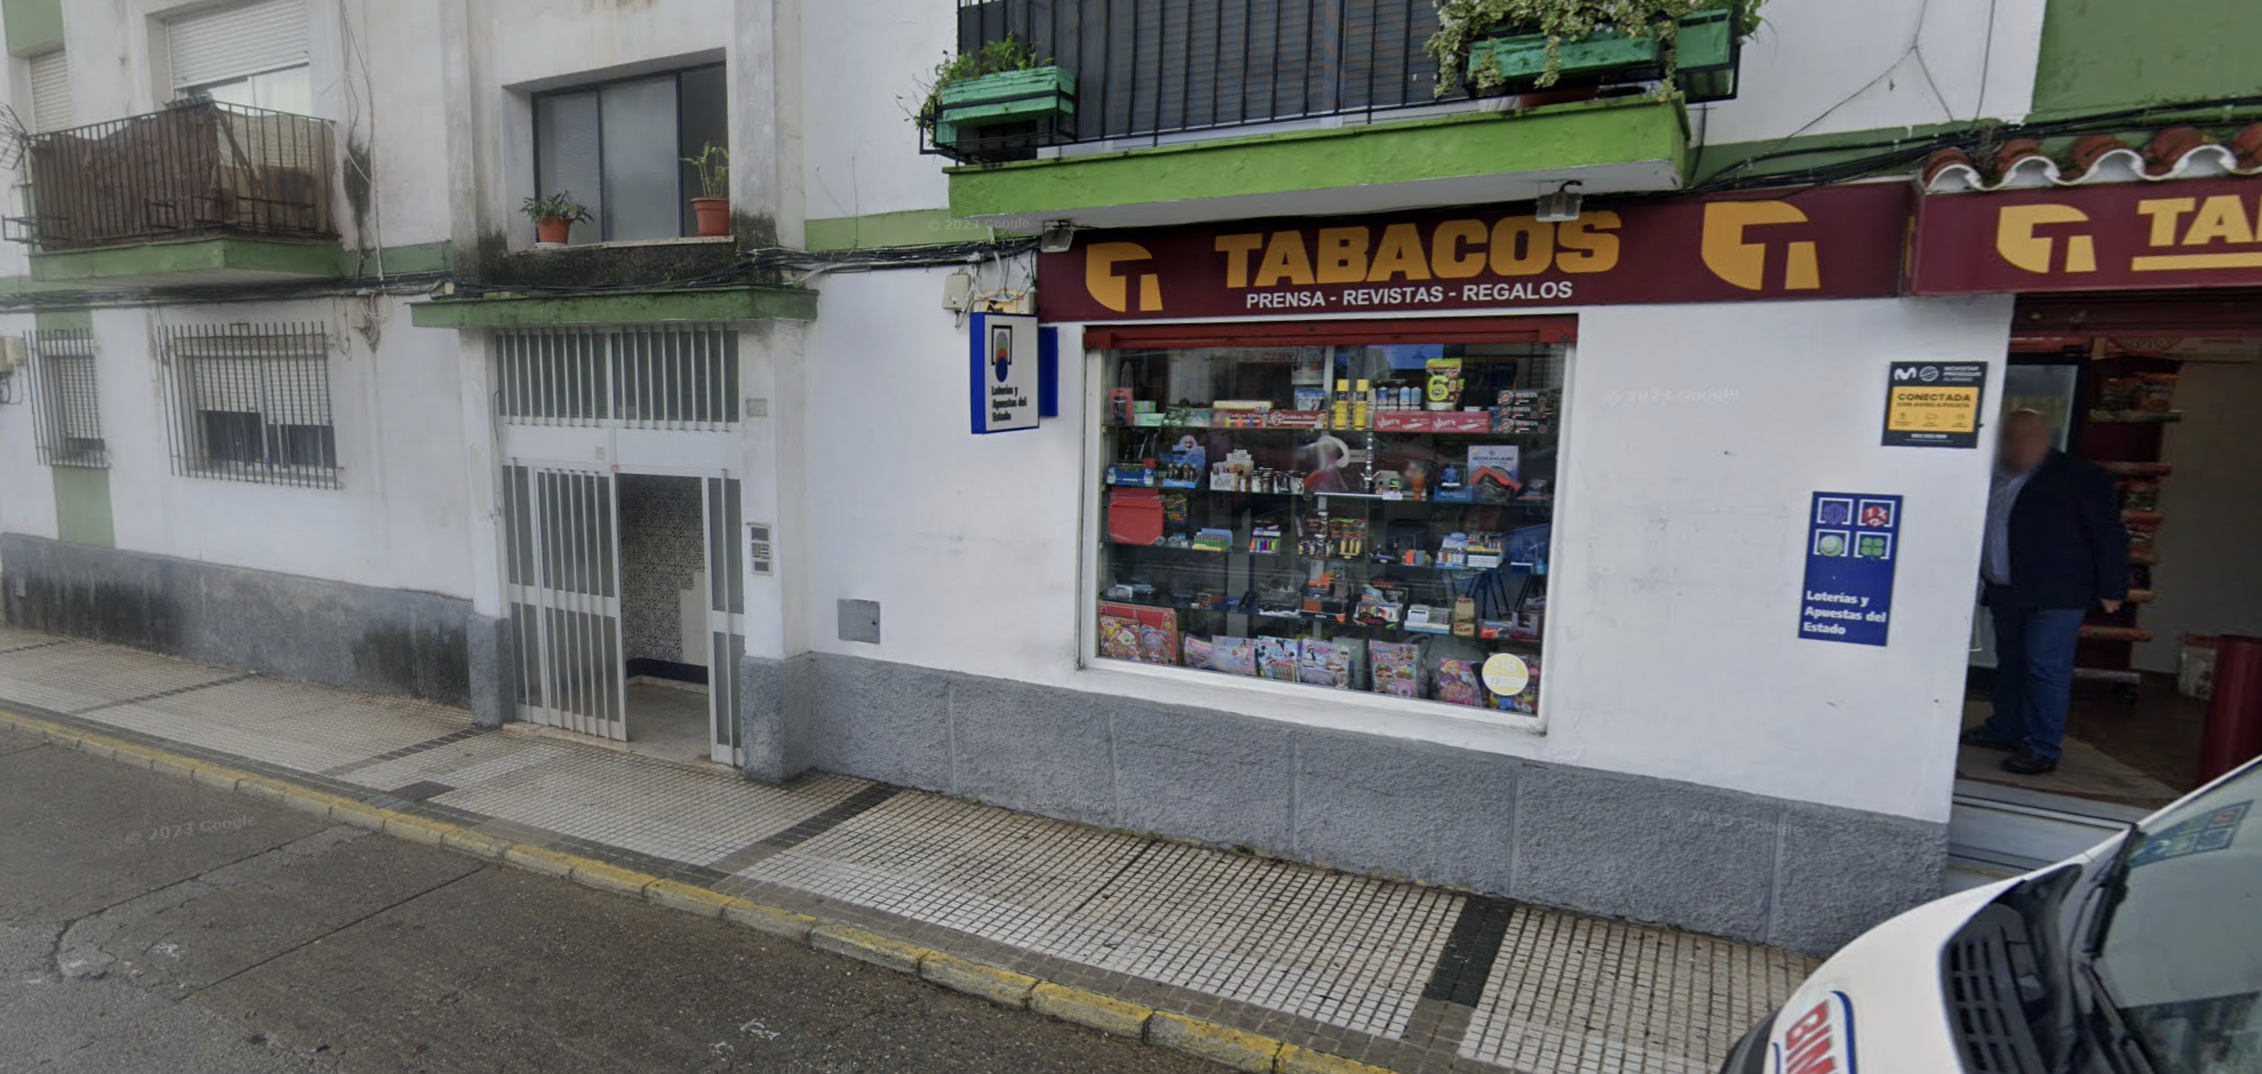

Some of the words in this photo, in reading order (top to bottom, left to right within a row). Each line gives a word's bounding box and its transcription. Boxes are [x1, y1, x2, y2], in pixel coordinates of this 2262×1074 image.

[2137, 194, 2262, 247] TA
[1214, 211, 1622, 289] TABACOS
[1246, 290, 1325, 309] PRENSA
[1342, 285, 1444, 307] REVISTAS
[1463, 280, 1573, 301] REGALOS
[1428, 375, 1449, 401] 6
[1897, 393, 1971, 402] CONECTADA
[1806, 590, 1858, 604] Loterías
[1860, 597, 1870, 607] y
[1804, 606, 1863, 621] Apuestas
[1866, 611, 1887, 623] del
[1803, 622, 1846, 635] Estado
